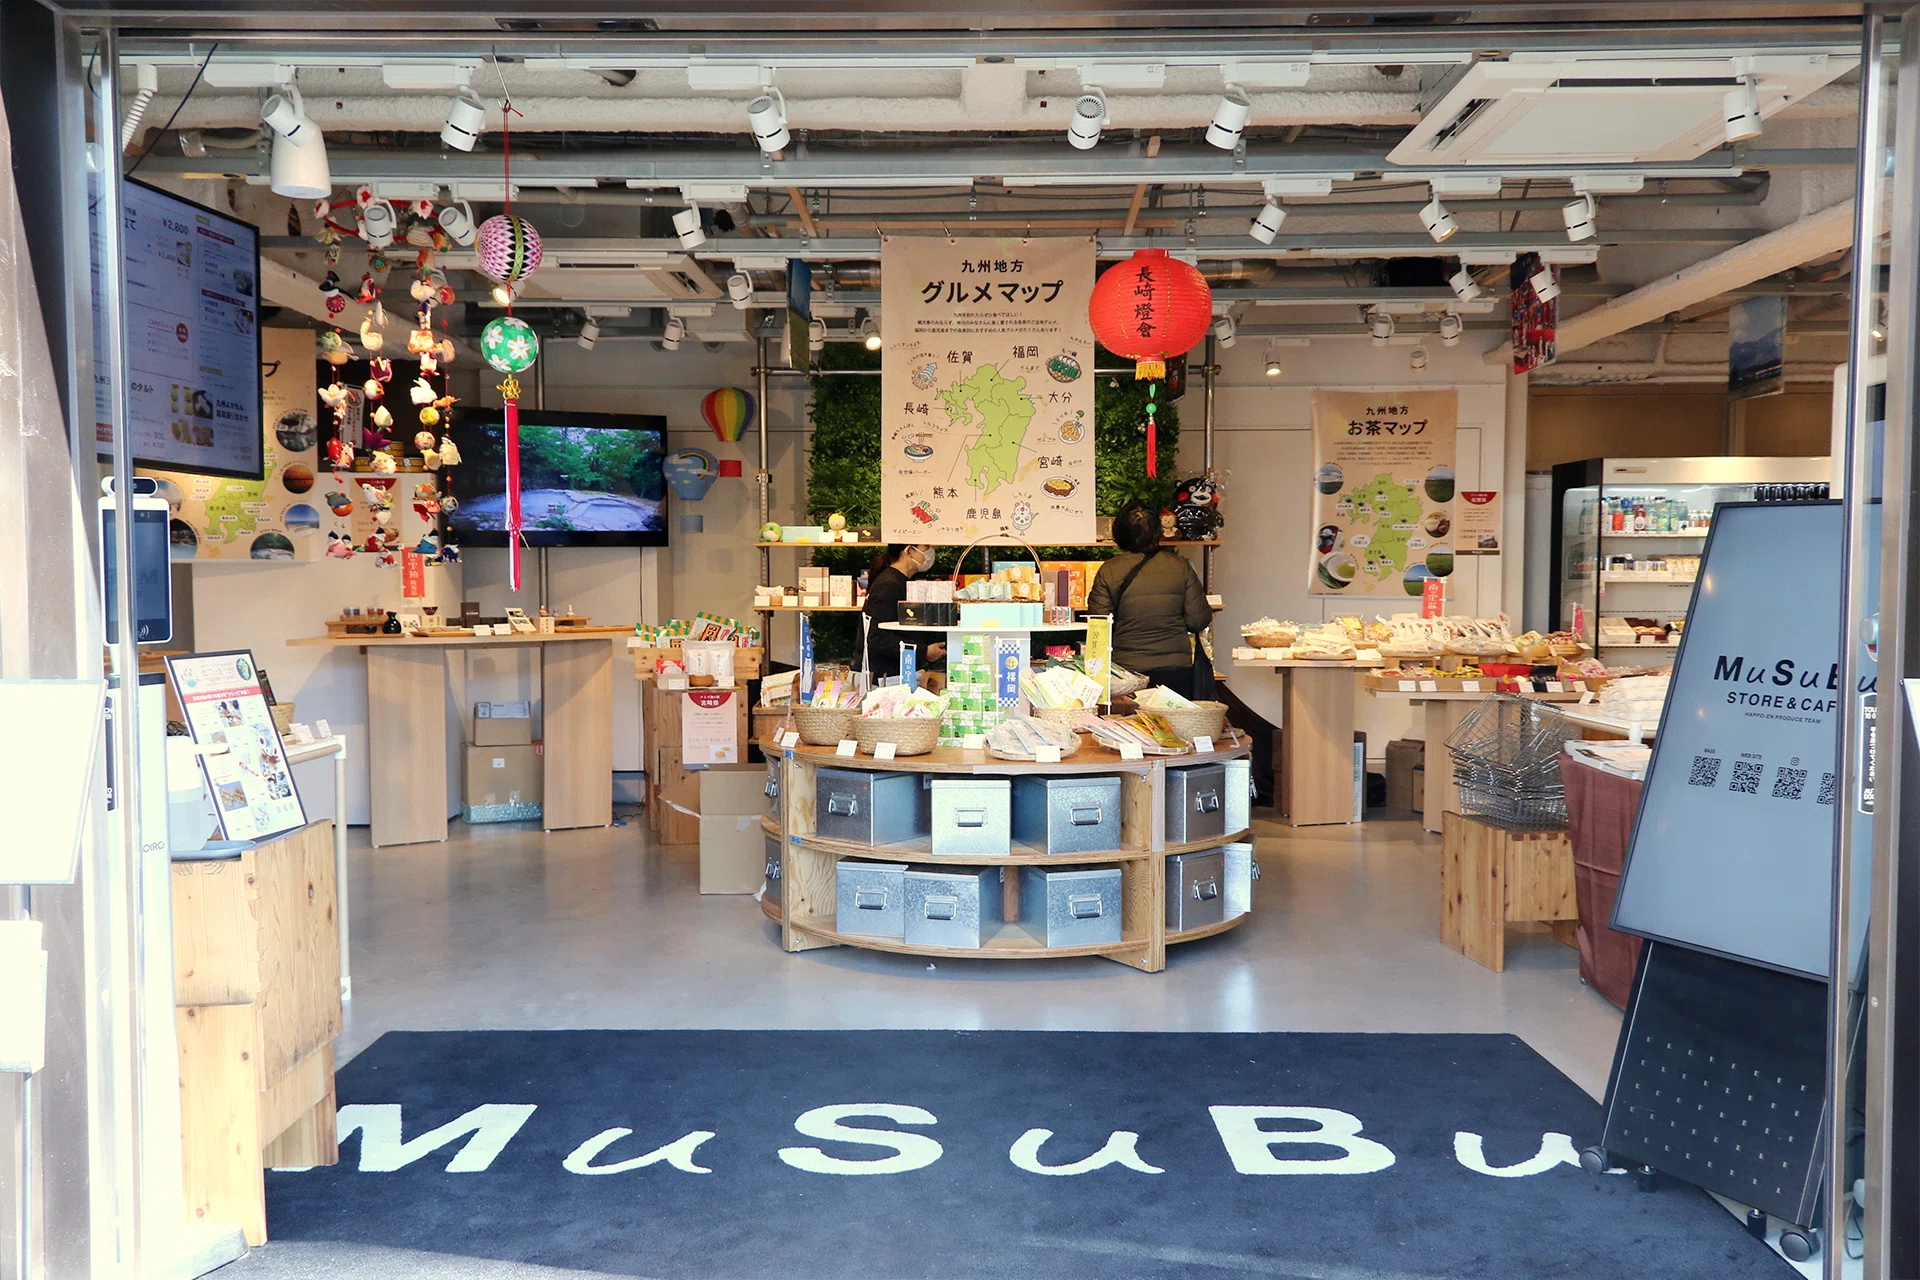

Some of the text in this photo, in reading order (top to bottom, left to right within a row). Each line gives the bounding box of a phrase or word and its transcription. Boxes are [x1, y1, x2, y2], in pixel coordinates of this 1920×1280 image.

[961, 259, 1025, 273] 九州地方
[921, 280, 1064, 304] グルメマップ
[1134, 265, 1157, 338] 長崎燈會
[947, 350, 973, 364] 佐賀
[1012, 345, 1039, 358] 福岡
[1048, 391, 1073, 403] 大分
[903, 402, 930, 416] 長崎
[1366, 406, 1409, 415] 九州地方
[1347, 419, 1429, 436] お茶マップ
[1037, 455, 1063, 469] 宮崎
[933, 486, 959, 499] 熊本
[966, 507, 1002, 520] 鹿児島
[1744, 711, 1774, 720] HAPPO-EN
[1775, 714, 1803, 723] PRODUCE
[272, 1103, 1629, 1176] MuSuBu
